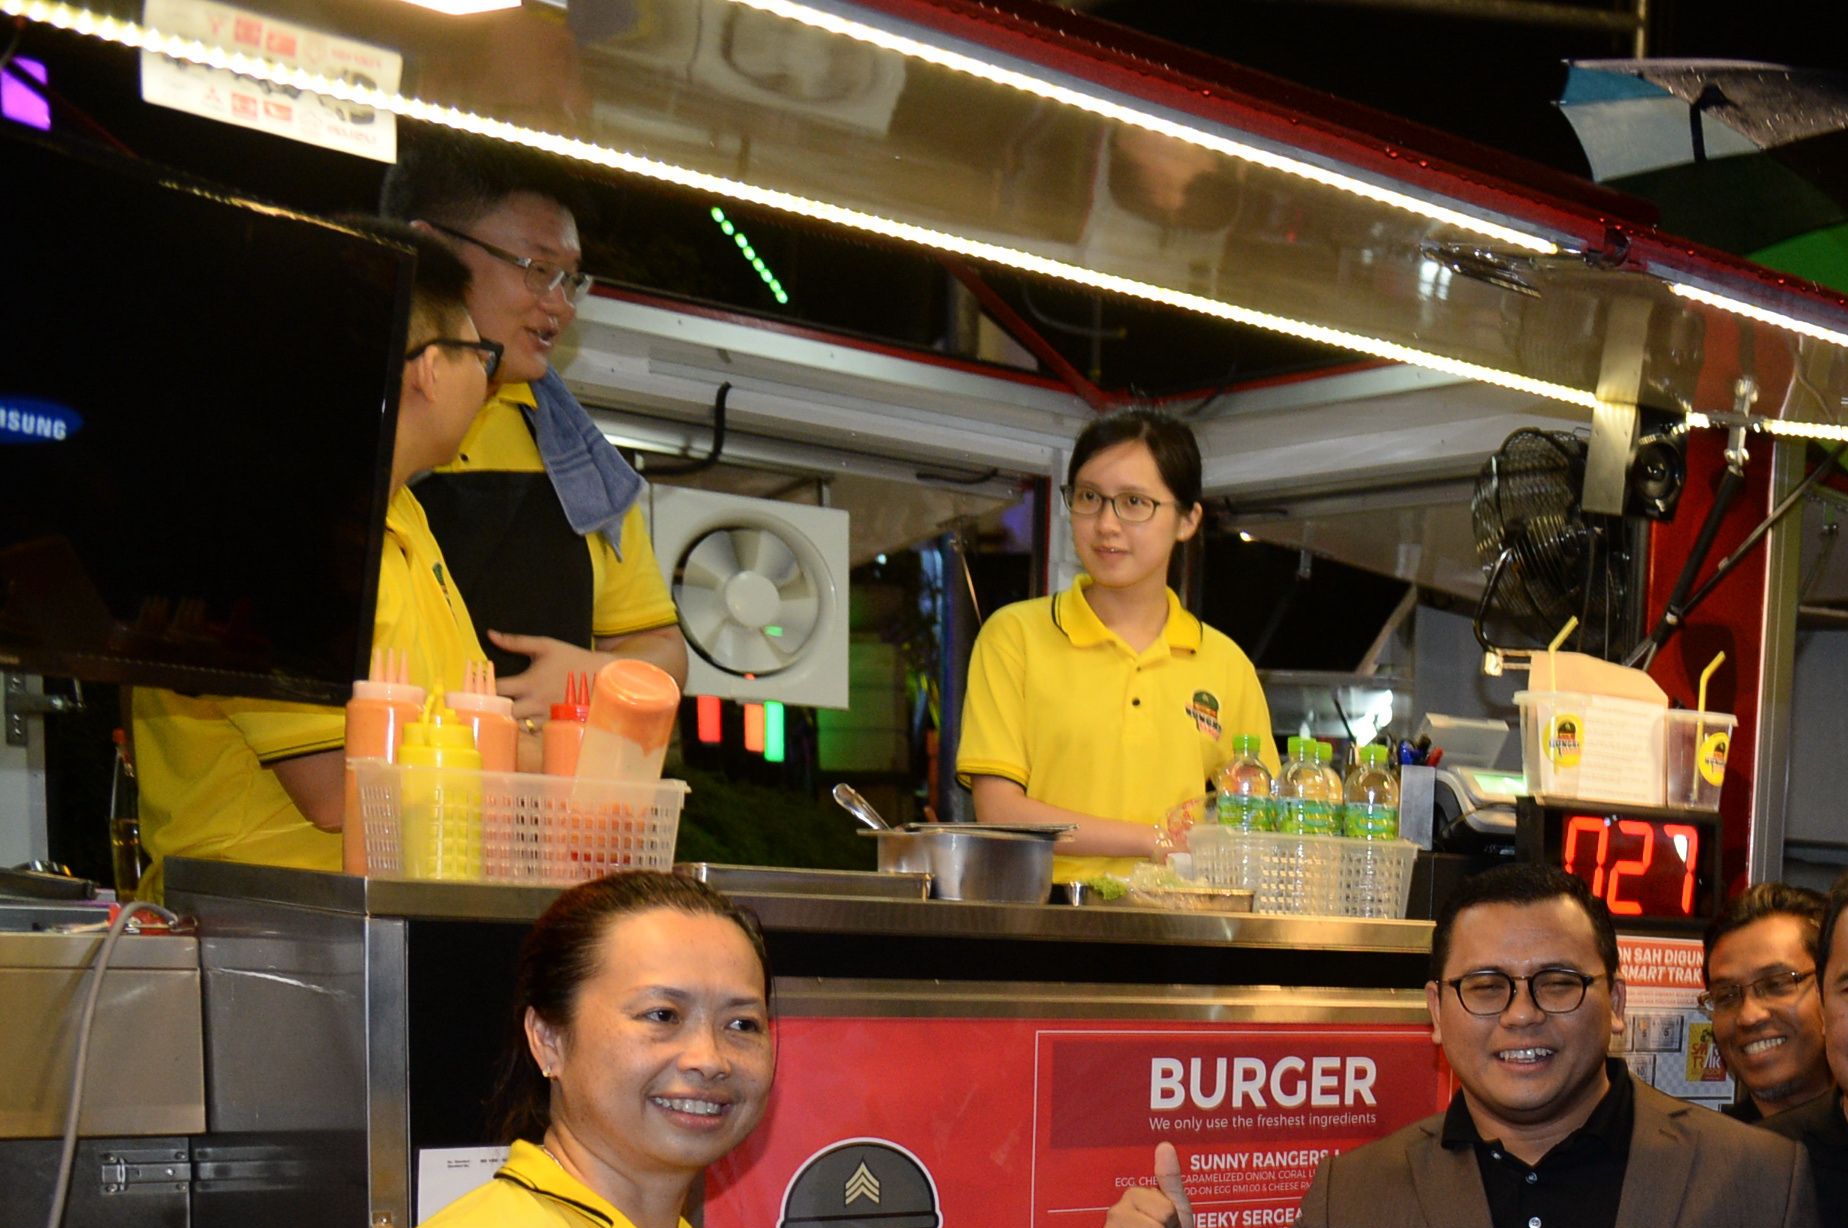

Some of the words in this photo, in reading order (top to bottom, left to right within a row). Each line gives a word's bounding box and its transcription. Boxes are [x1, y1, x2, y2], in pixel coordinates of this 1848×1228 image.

[1634, 947, 1662, 964] SAH
[1664, 949, 1704, 965] DIGUN
[1150, 1056, 1378, 1110] BURGER
[1149, 1117, 1171, 1131] We
[1174, 1115, 1201, 1132] only
[1206, 1117, 1228, 1129] use
[1232, 1115, 1253, 1128] the
[1257, 1113, 1305, 1128] freshest
[1308, 1112, 1377, 1129] ingredients
[1190, 1152, 1250, 1170] SUNNY
[1278, 1169, 1306, 1180] CORAL
[1213, 1184, 1231, 1194] EGG
[1268, 1181, 1299, 1192] CHEESE
[1241, 1207, 1303, 1226] SERGEA
